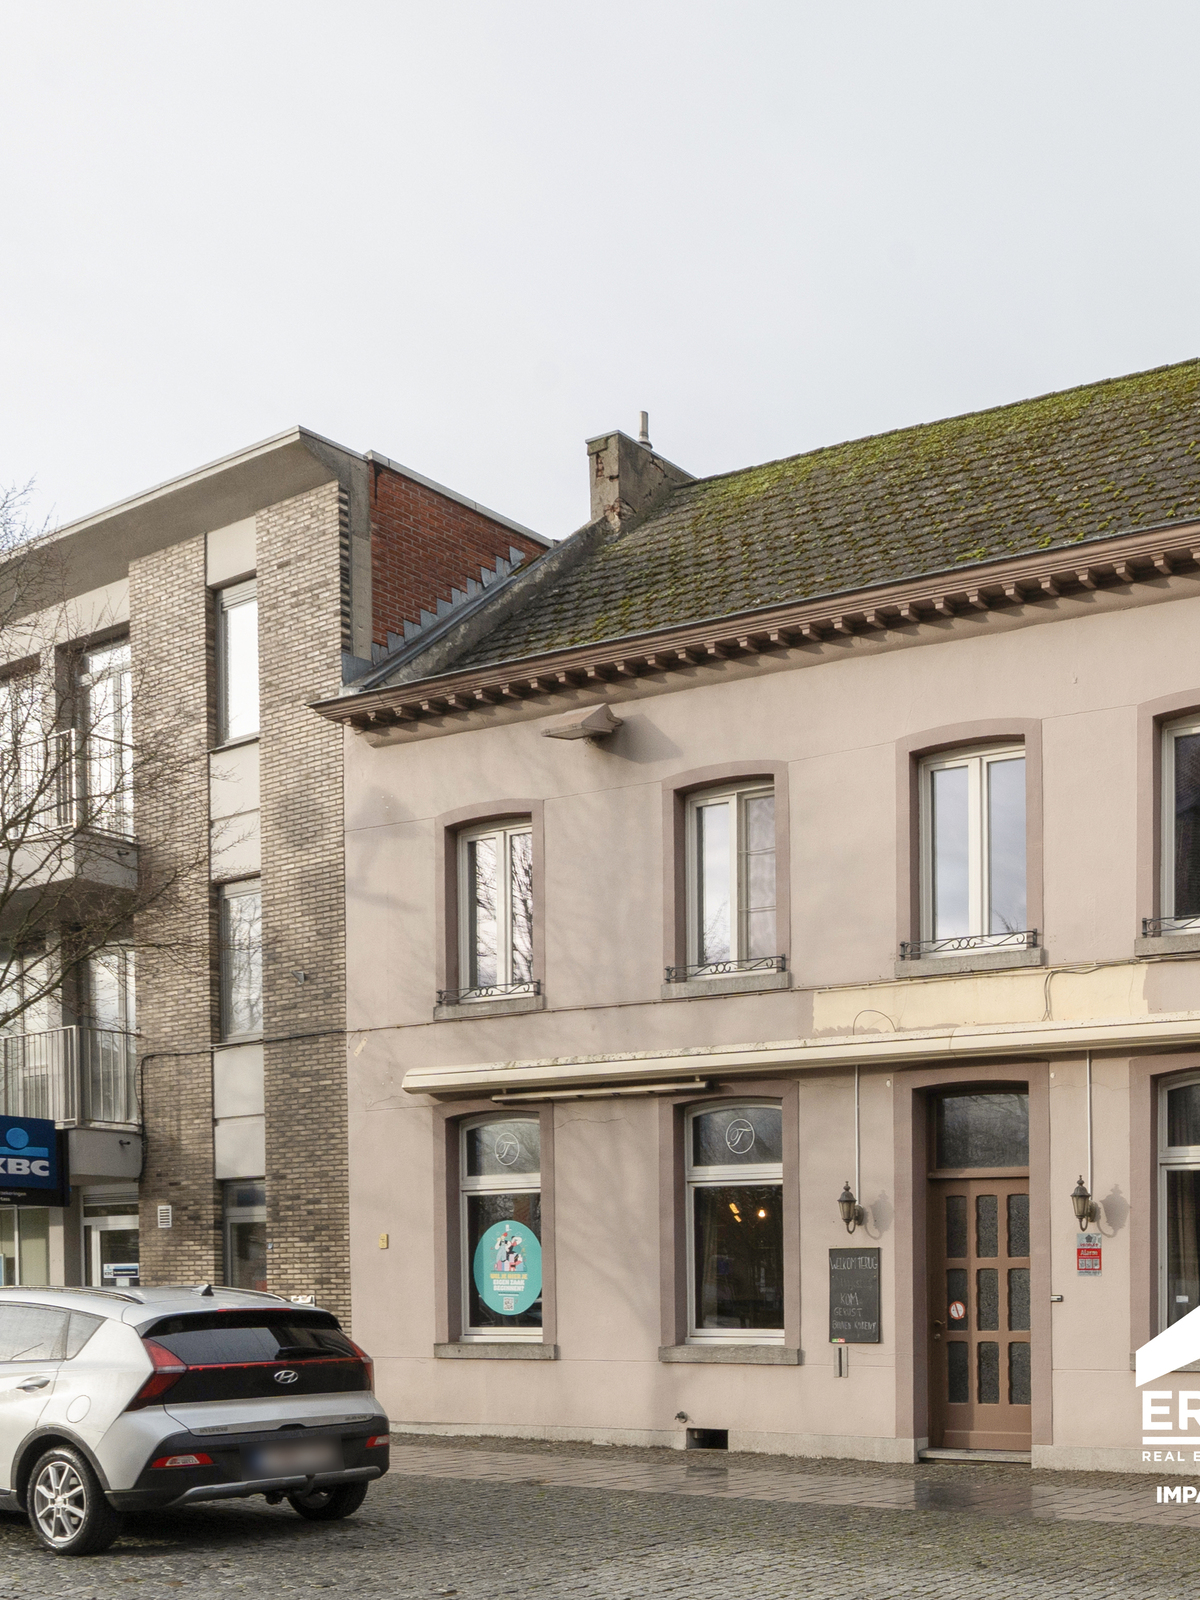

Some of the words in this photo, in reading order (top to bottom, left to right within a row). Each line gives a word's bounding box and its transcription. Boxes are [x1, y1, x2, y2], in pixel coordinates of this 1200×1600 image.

[0, 1157, 50, 1176] BC
[857, 1256, 878, 1270] TERUG
[840, 1292, 859, 1306] KOM
